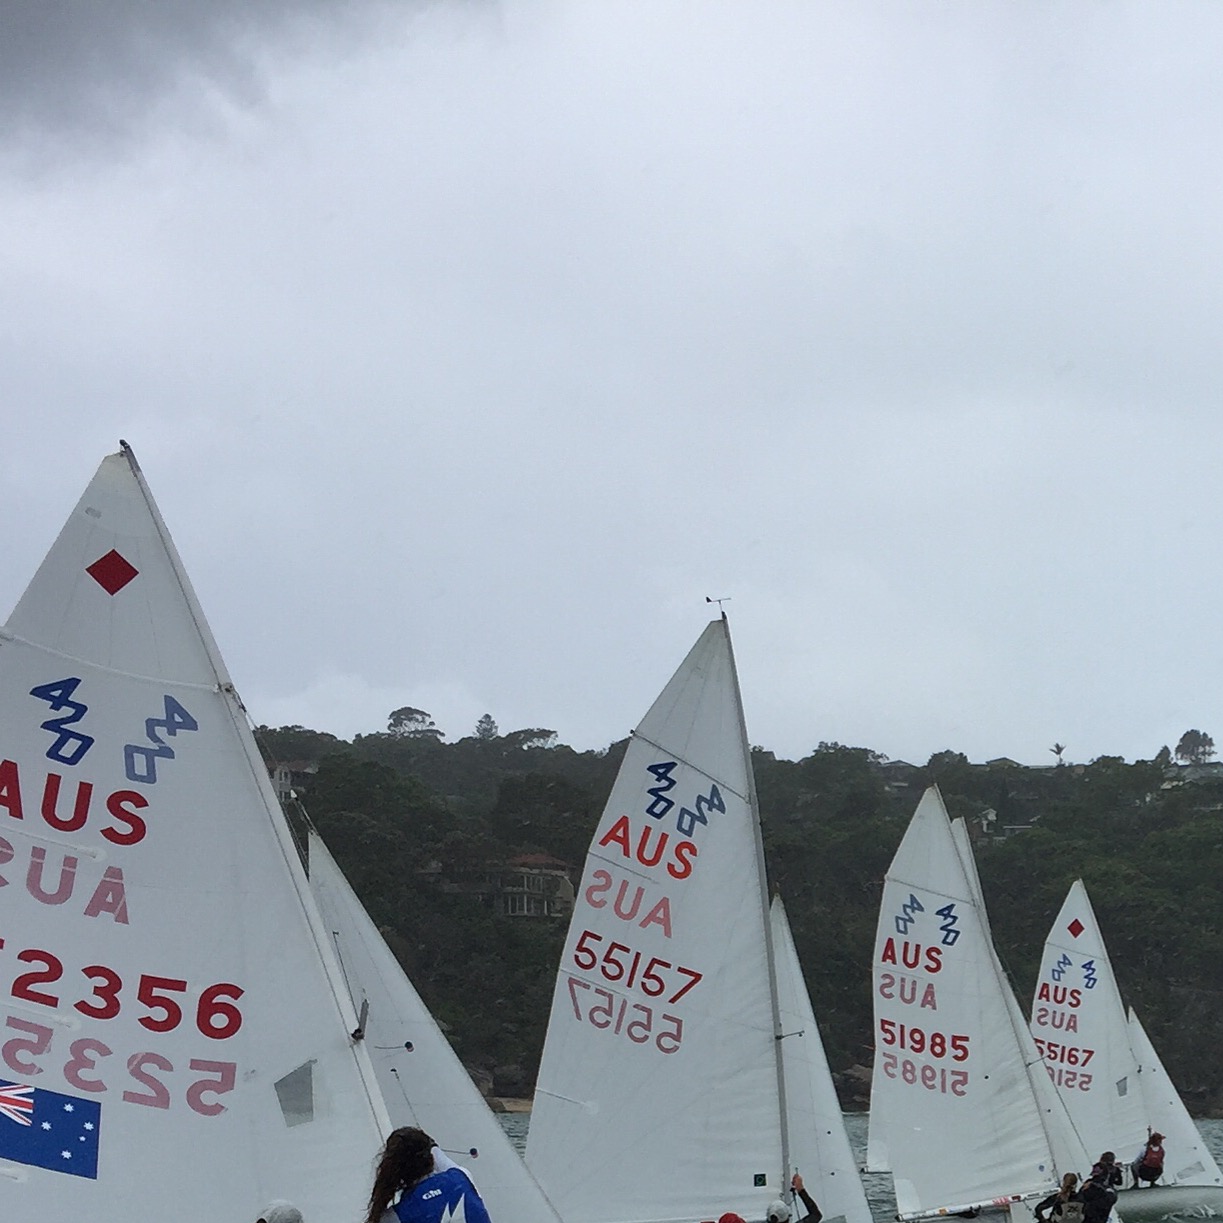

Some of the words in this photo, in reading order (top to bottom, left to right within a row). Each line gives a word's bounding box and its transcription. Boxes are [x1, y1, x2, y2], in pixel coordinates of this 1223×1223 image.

[0, 759, 149, 846] AUS
[599, 815, 698, 880] AUS
[574, 930, 703, 1004] 55157
[881, 937, 943, 973] AUS
[0, 938, 245, 1040] 2356
[1038, 982, 1082, 1008] AUS
[880, 1018, 970, 1062] 51985
